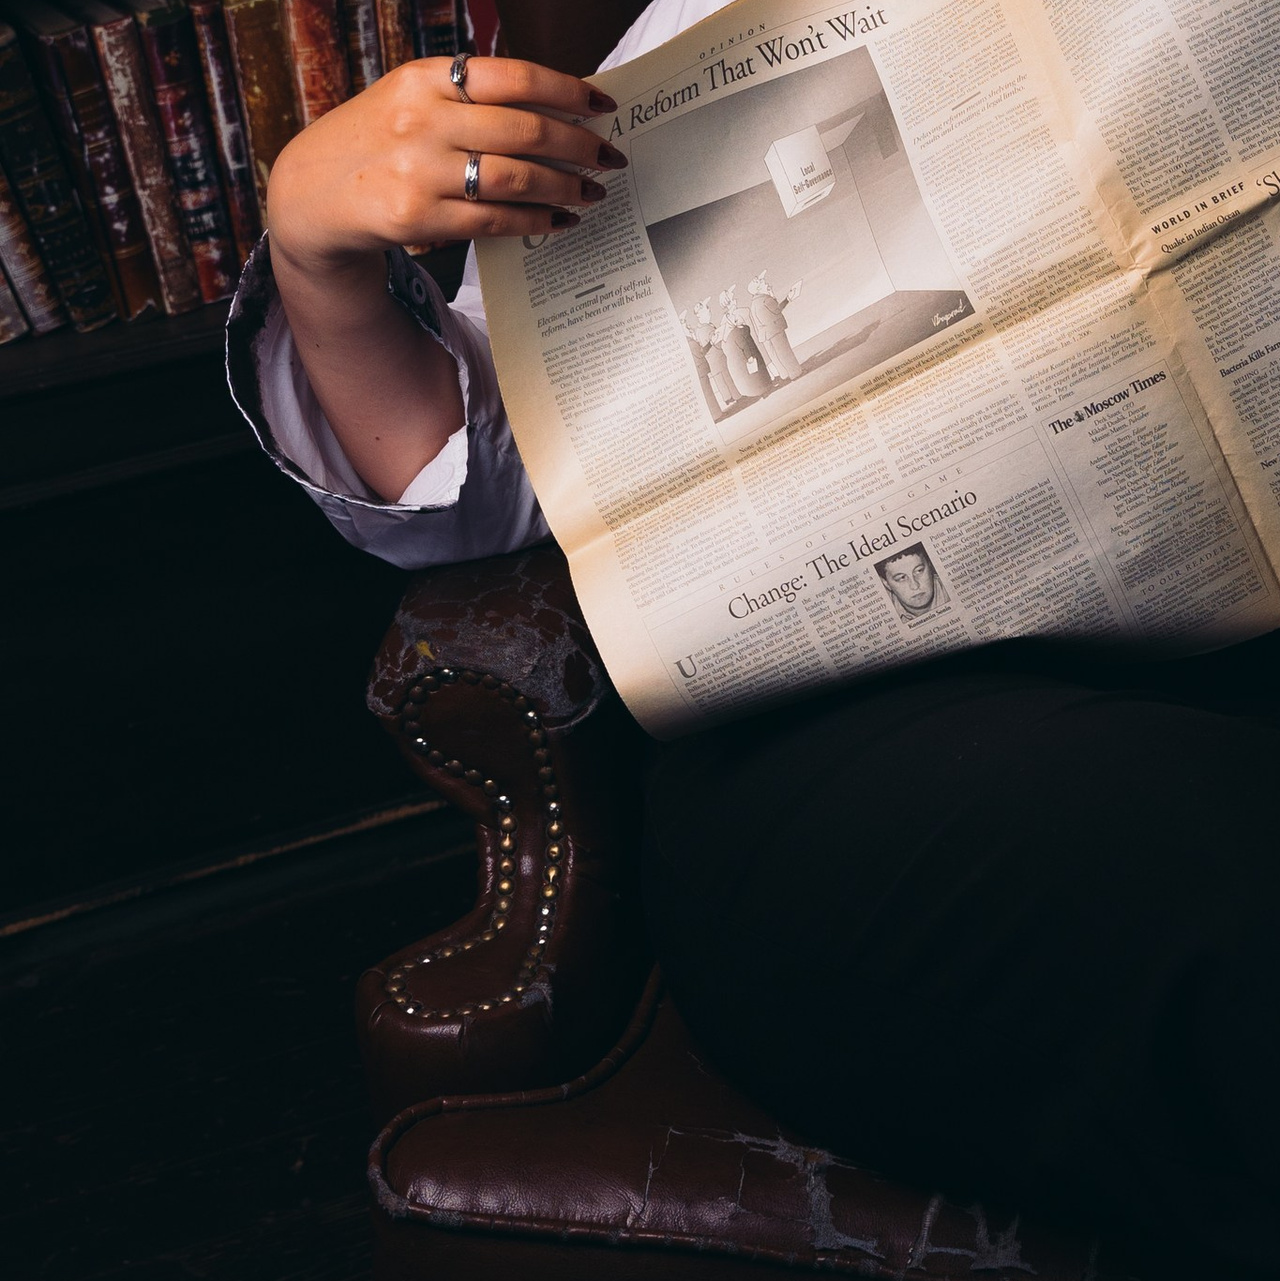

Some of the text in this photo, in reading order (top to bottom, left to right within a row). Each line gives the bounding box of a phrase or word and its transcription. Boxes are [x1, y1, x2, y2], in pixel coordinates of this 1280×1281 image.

[698, 22, 766, 60] OPINION
[608, 5, 888, 142] A Reform That Won't Wait
[792, 167, 834, 195] Self-Governance
[799, 160, 816, 177] Local
[1150, 180, 1244, 235] WORLD IN BRIEF
[1160, 208, 1241, 254] Quake in Indian Ocean
[536, 274, 652, 329] Elections, a central part of self-rule
[540, 285, 654, 338] reform, have been or will be held.
[1218, 357, 1250, 378] Bacteria
[1246, 348, 1266, 363] Kills
[1047, 370, 1167, 435] The Moscow Times
[1259, 457, 1278, 471] New
[804, 533, 827, 549] OF
[847, 503, 887, 527] THE
[906, 466, 963, 499] GAME
[727, 489, 977, 619] Change: The Ideal Scenario
[1140, 541, 1232, 596] TO OUR READERS
